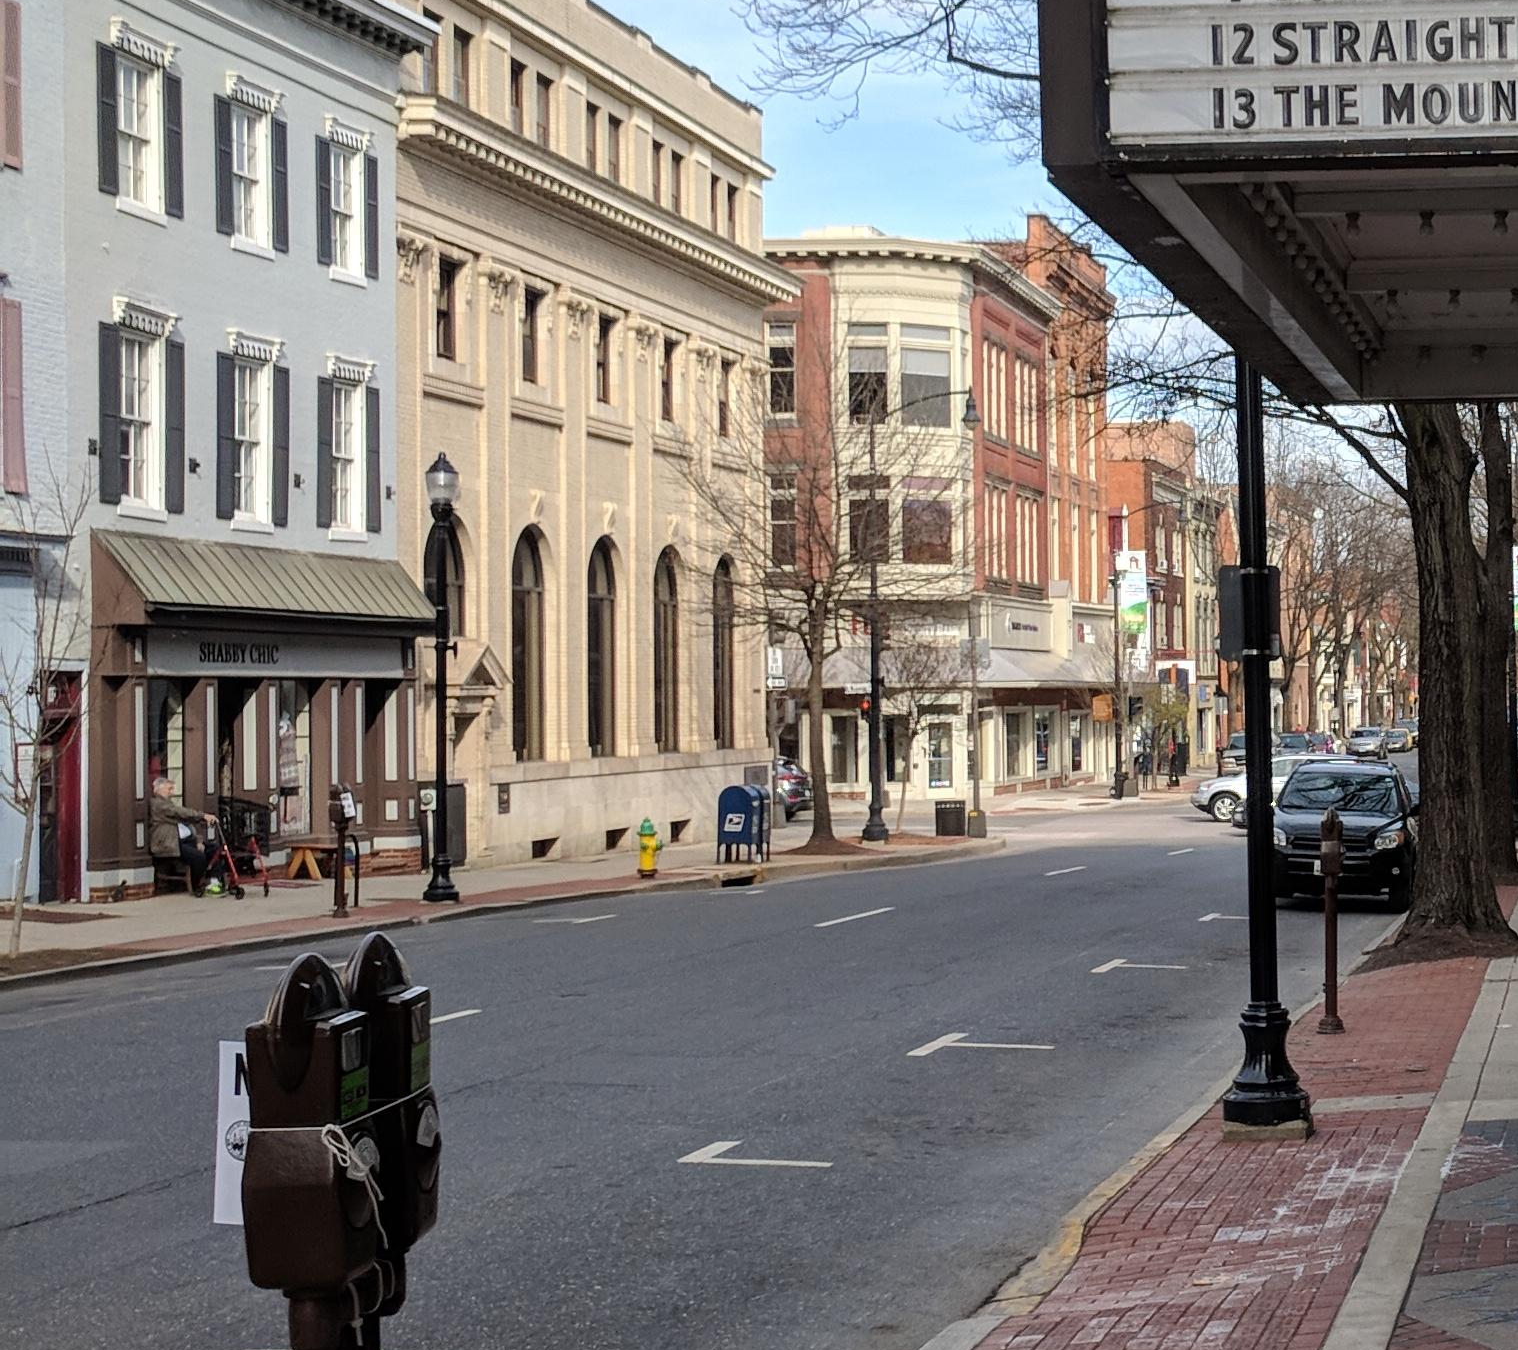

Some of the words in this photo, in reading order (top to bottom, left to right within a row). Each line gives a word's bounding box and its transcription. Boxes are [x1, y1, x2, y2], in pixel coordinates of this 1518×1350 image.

[1211, 22, 1255, 65] 12
[1271, 14, 1515, 65] STRAIGHT
[1212, 86, 1256, 129] 13
[1273, 83, 1359, 127] THE
[200, 642, 247, 663] SHABBY
[249, 643, 279, 664] CHIC
